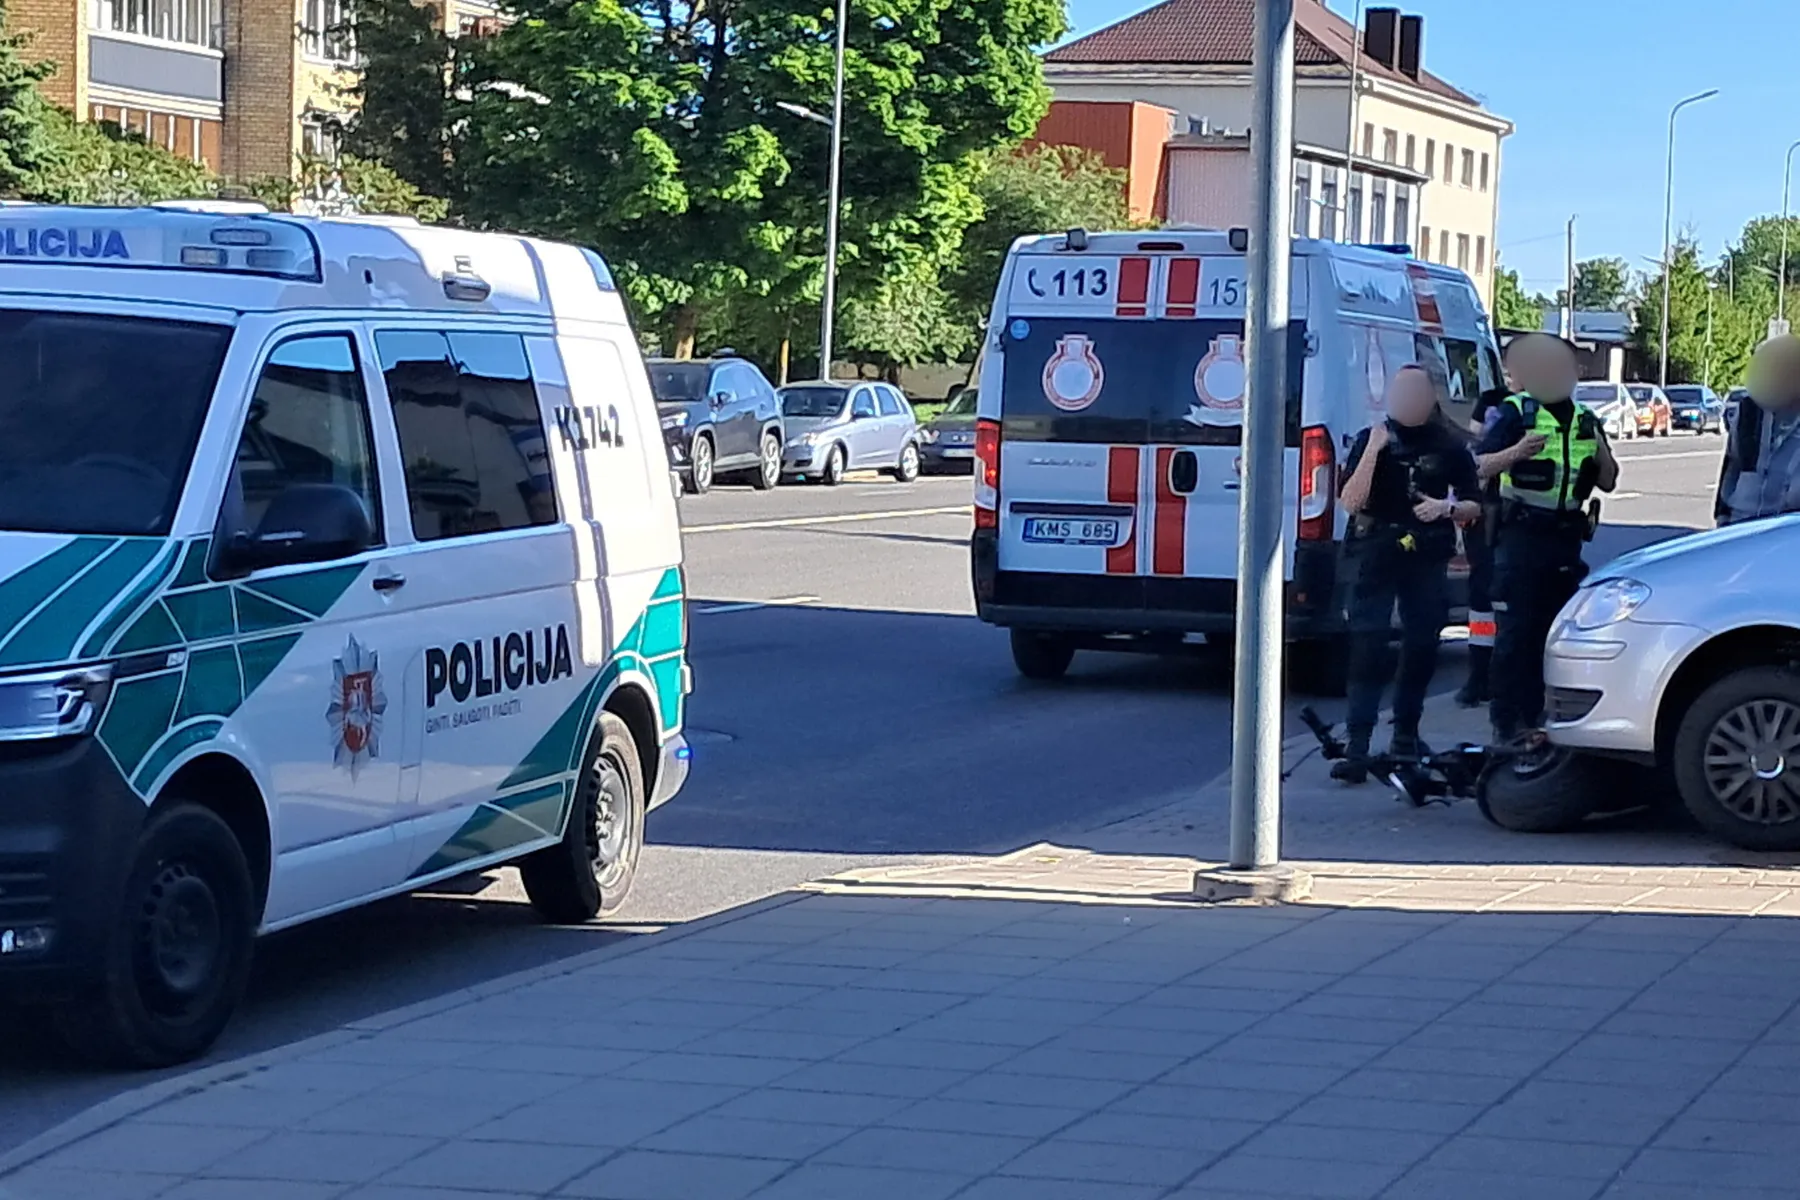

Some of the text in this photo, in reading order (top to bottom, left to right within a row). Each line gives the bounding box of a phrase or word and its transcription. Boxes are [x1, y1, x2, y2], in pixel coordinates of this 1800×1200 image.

[0, 226, 130, 259] LICIJA
[1052, 267, 1108, 297] 113
[1034, 521, 1113, 538] KMS 685
[425, 623, 573, 708] POLICIJA
